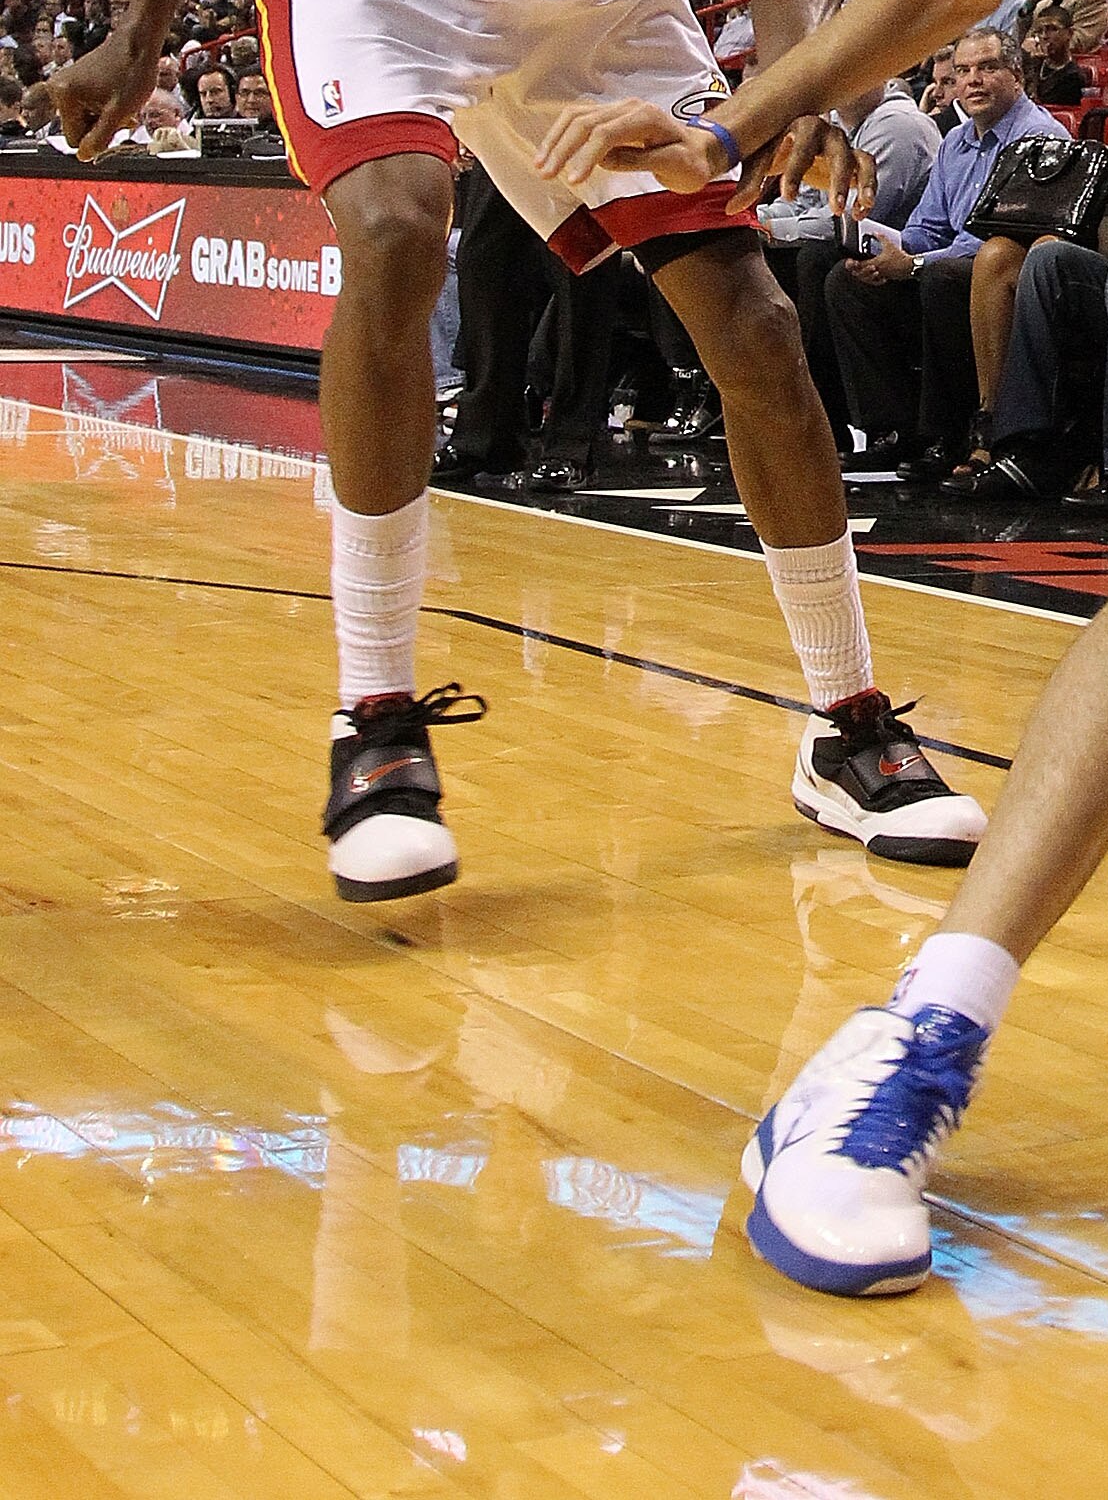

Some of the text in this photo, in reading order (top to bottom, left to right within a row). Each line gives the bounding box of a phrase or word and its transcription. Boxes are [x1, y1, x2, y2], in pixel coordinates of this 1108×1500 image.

[62, 222, 182, 282] Budweiser
[191, 236, 266, 288] GRAB
[266, 257, 319, 293] SOME
